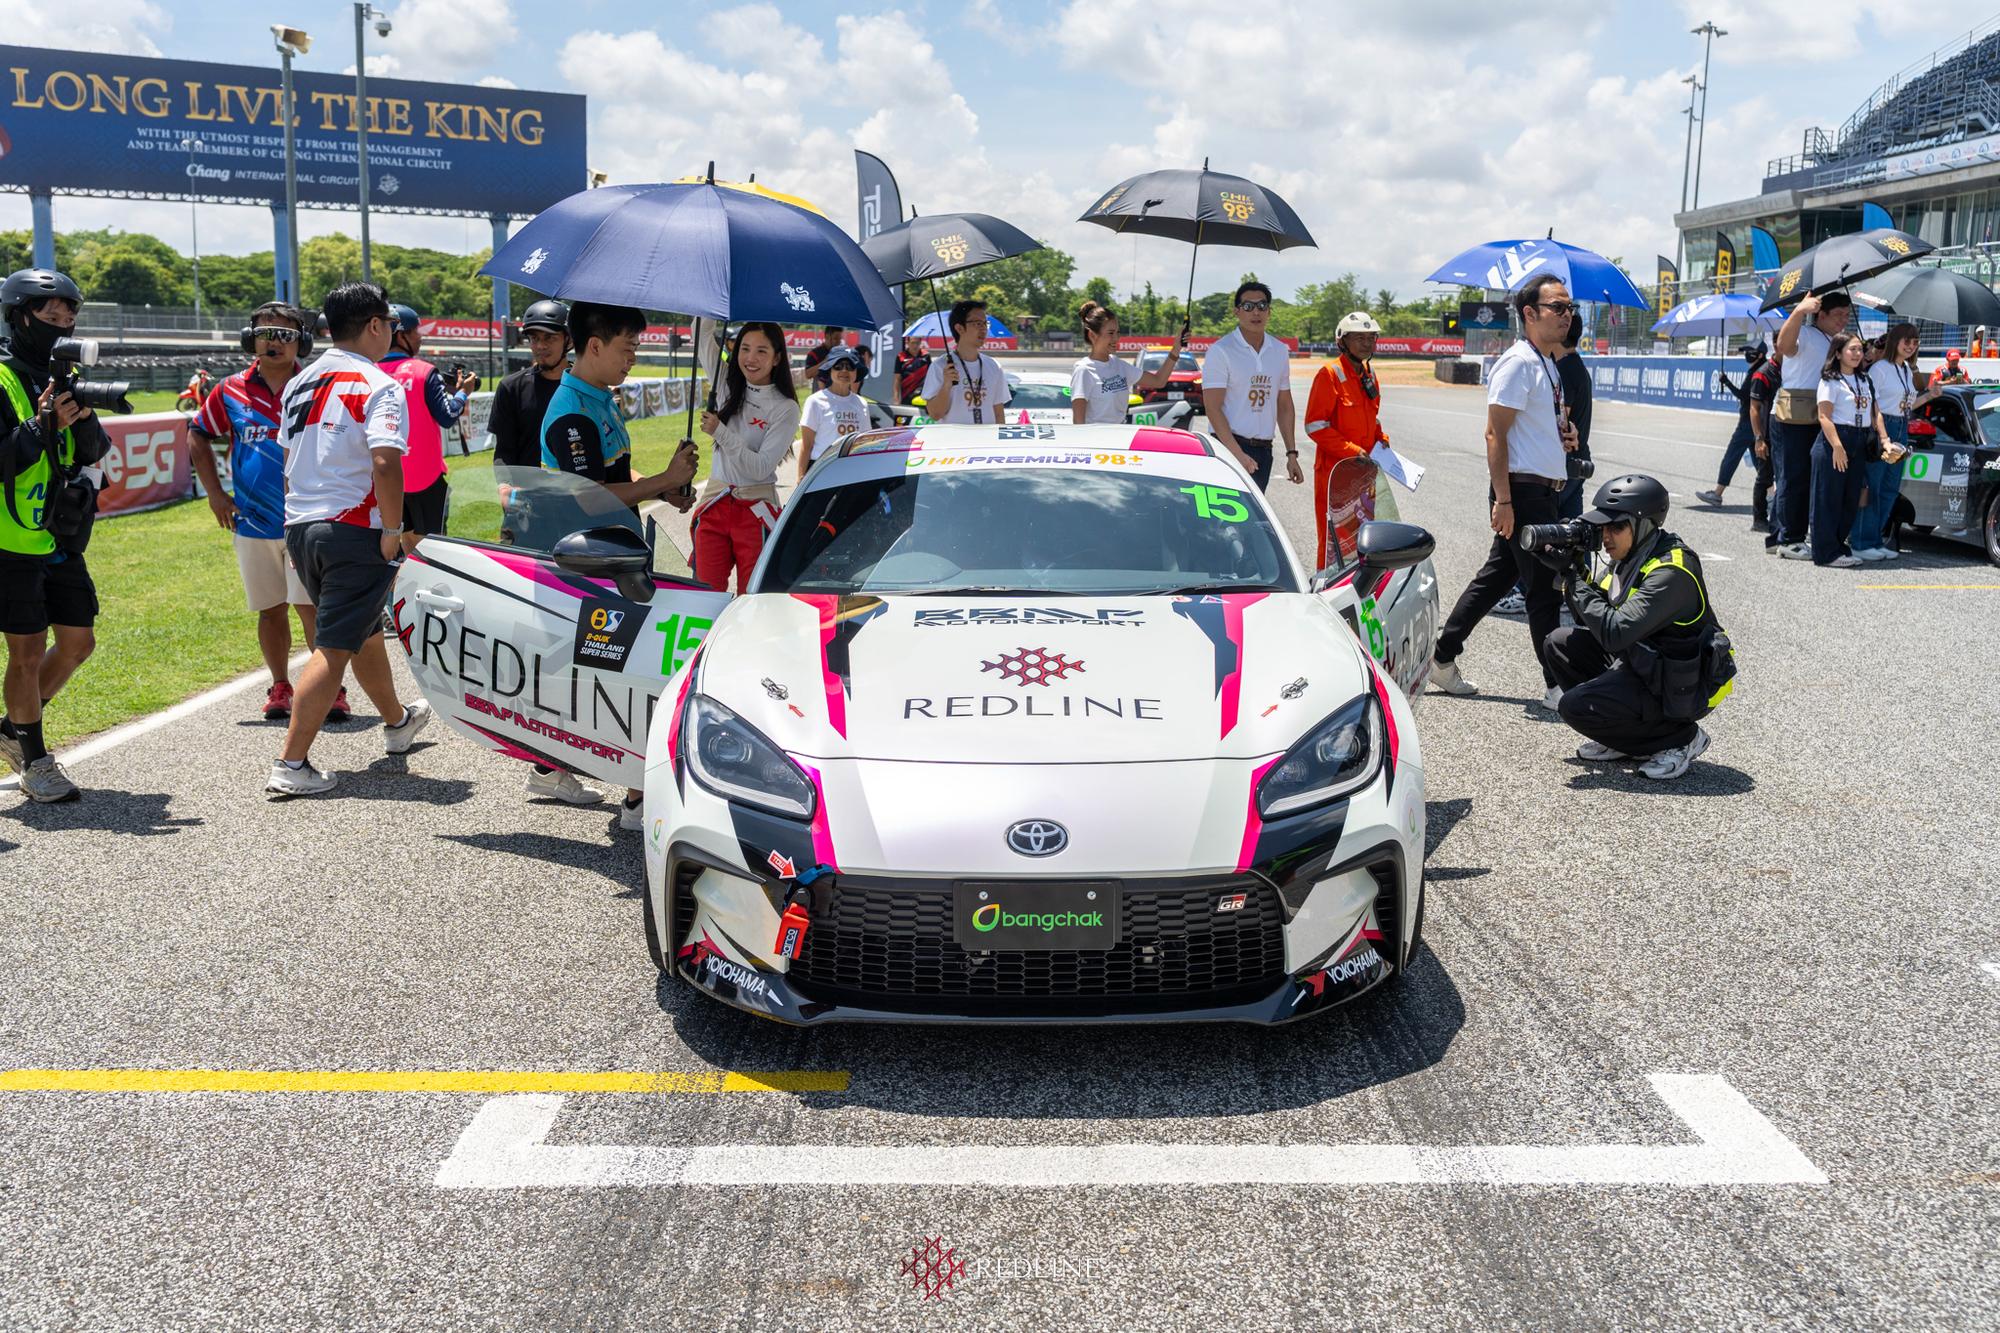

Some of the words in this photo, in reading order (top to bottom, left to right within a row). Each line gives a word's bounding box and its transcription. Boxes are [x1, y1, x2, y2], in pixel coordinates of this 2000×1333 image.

[9, 67, 172, 118] LONG
[184, 81, 301, 127] LIVE
[311, 91, 414, 136] THE
[424, 101, 545, 145] KING
[137, 127, 171, 139] WITH
[175, 129, 199, 141] THE
[201, 132, 250, 145] UTMOST
[254, 135, 301, 148] RESPET
[305, 138, 338, 151] FROM
[366, 144, 443, 158] MANAGEMENT
[127, 139, 154, 150] AND
[158, 141, 190, 152] TEAM
[194, 143, 249, 157] MEMBERS
[252, 146, 268, 157] OF
[270, 149, 313, 162] CHNG
[406, 157, 453, 170] CIRCUIT
[186, 163, 231, 181] Chang
[234, 169, 316, 184] INTERNATNAL
[437, 326, 502, 338] HONDA
[983, 341, 1008, 350] NDA
[1376, 343, 1410, 352] HONDA
[1648, 369, 1669, 388] YAMAHA
[1680, 370, 1705, 391] YAMAHA
[1674, 391, 1702, 399] RACING
[125, 430, 175, 489] 5G
[966, 455, 1091, 465] PREMIUM
[1095, 453, 1143, 466] 98+
[1180, 485, 1249, 523] 15
[914, 618, 1146, 627] MOTORSPORT
[584, 640, 625, 653] THAILAND
[586, 632, 611, 643] B-QUIK
[656, 613, 713, 677] 15
[580, 647, 600, 658] SUPER
[600, 650, 622, 660] SERIES
[903, 695, 1164, 720] REDLINE
[514, 712, 625, 764] MOTORSPORT
[1220, 899, 1245, 911] GR
[1002, 911, 1103, 932] bangchak
[781, 929, 797, 957] parco
[706, 954, 766, 996] YOKOHAMA
[1327, 948, 1379, 985] YOKOHAMA
